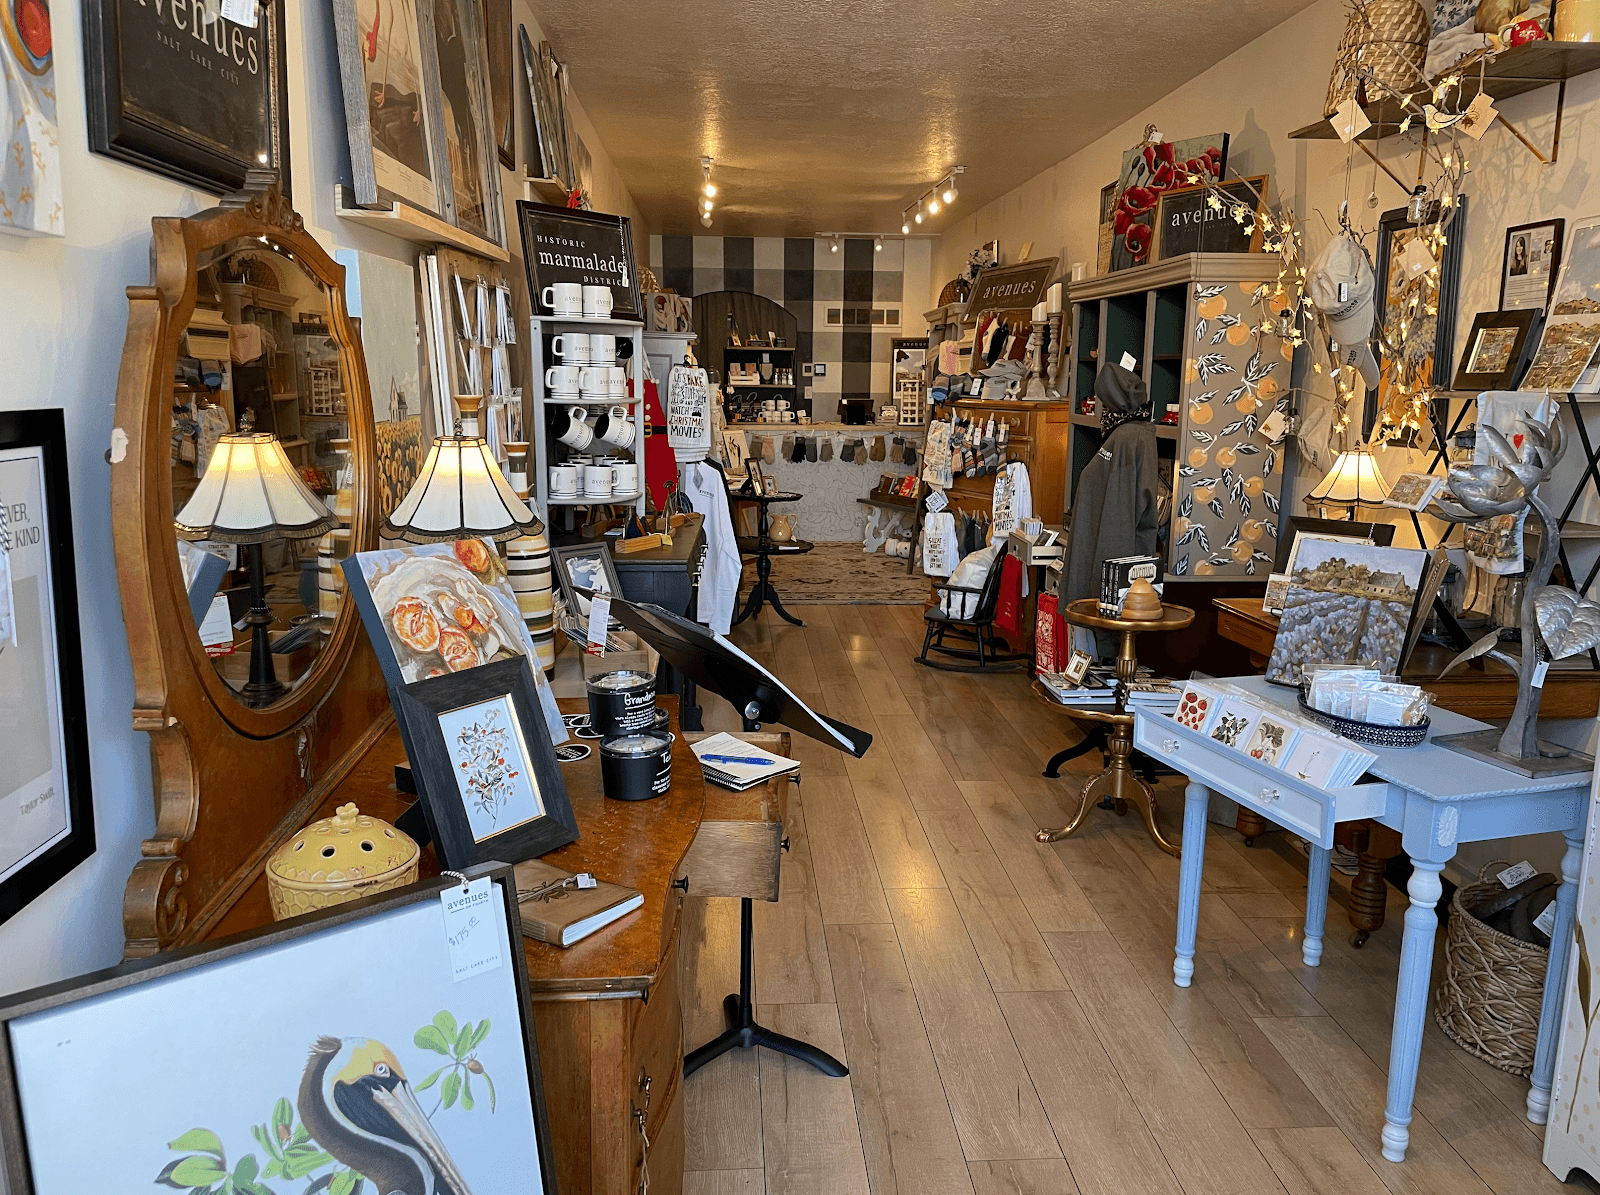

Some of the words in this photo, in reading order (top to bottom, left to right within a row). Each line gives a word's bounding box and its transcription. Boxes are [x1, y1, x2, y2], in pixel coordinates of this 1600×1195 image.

[134, 0, 258, 75] enues
[156, 30, 180, 52] SALT
[190, 49, 212, 71] LAKE
[221, 68, 239, 86] CITY
[536, 234, 586, 249] HISTORIC
[538, 251, 624, 274] marmalade
[583, 275, 622, 286] DISTRIC
[983, 280, 1037, 299] avenues
[2, 502, 31, 524] VER,
[15, 526, 41, 549] KIND
[19, 797, 40, 816] Taylor
[39, 786, 55, 804] Swift
[447, 890, 489, 910] avenues
